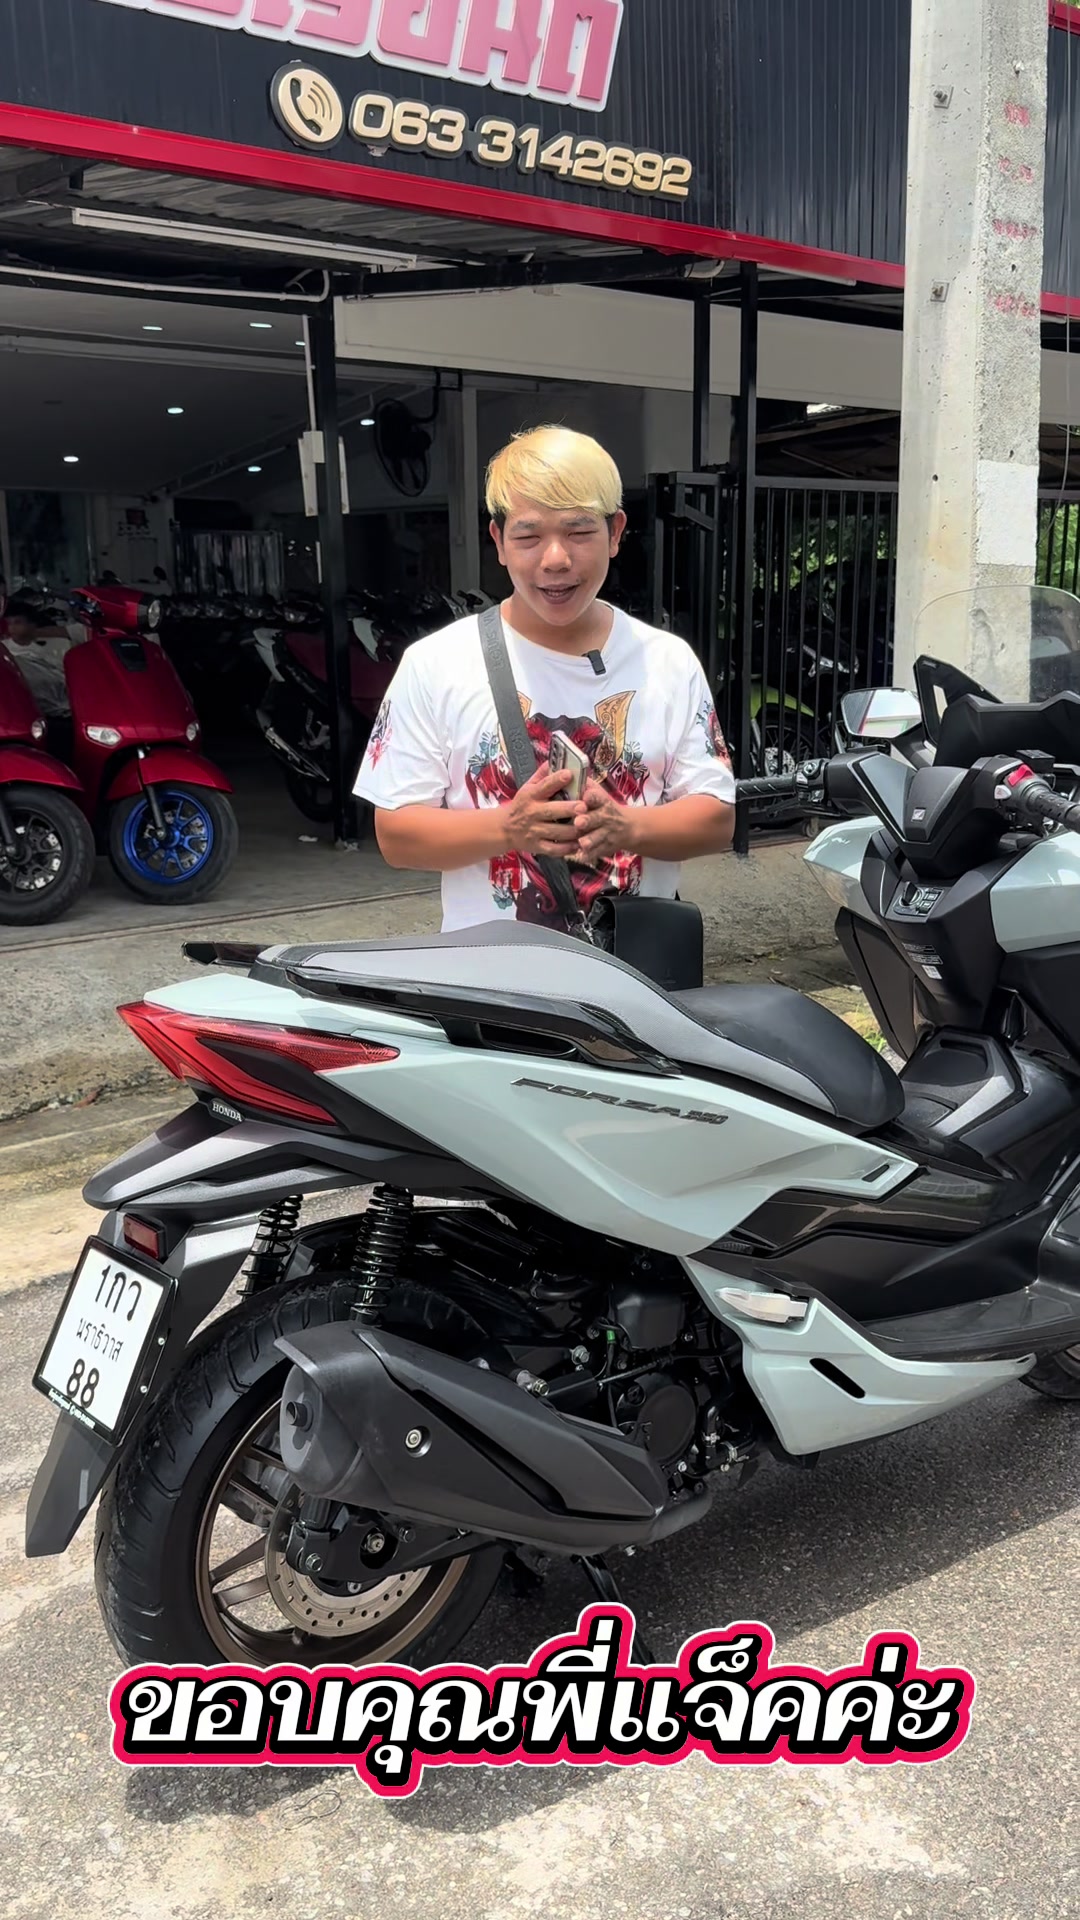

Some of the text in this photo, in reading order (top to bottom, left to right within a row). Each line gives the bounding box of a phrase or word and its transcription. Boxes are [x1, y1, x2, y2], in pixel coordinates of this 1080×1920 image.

[354, 96, 692, 196] 063 3142692
[212, 1101, 242, 1122] HONDA
[511, 1077, 681, 1117] FORZA
[95, 1264, 142, 1321] 1กว
[75, 1317, 124, 1362] นราธิวาส
[66, 1358, 100, 1409] 88
